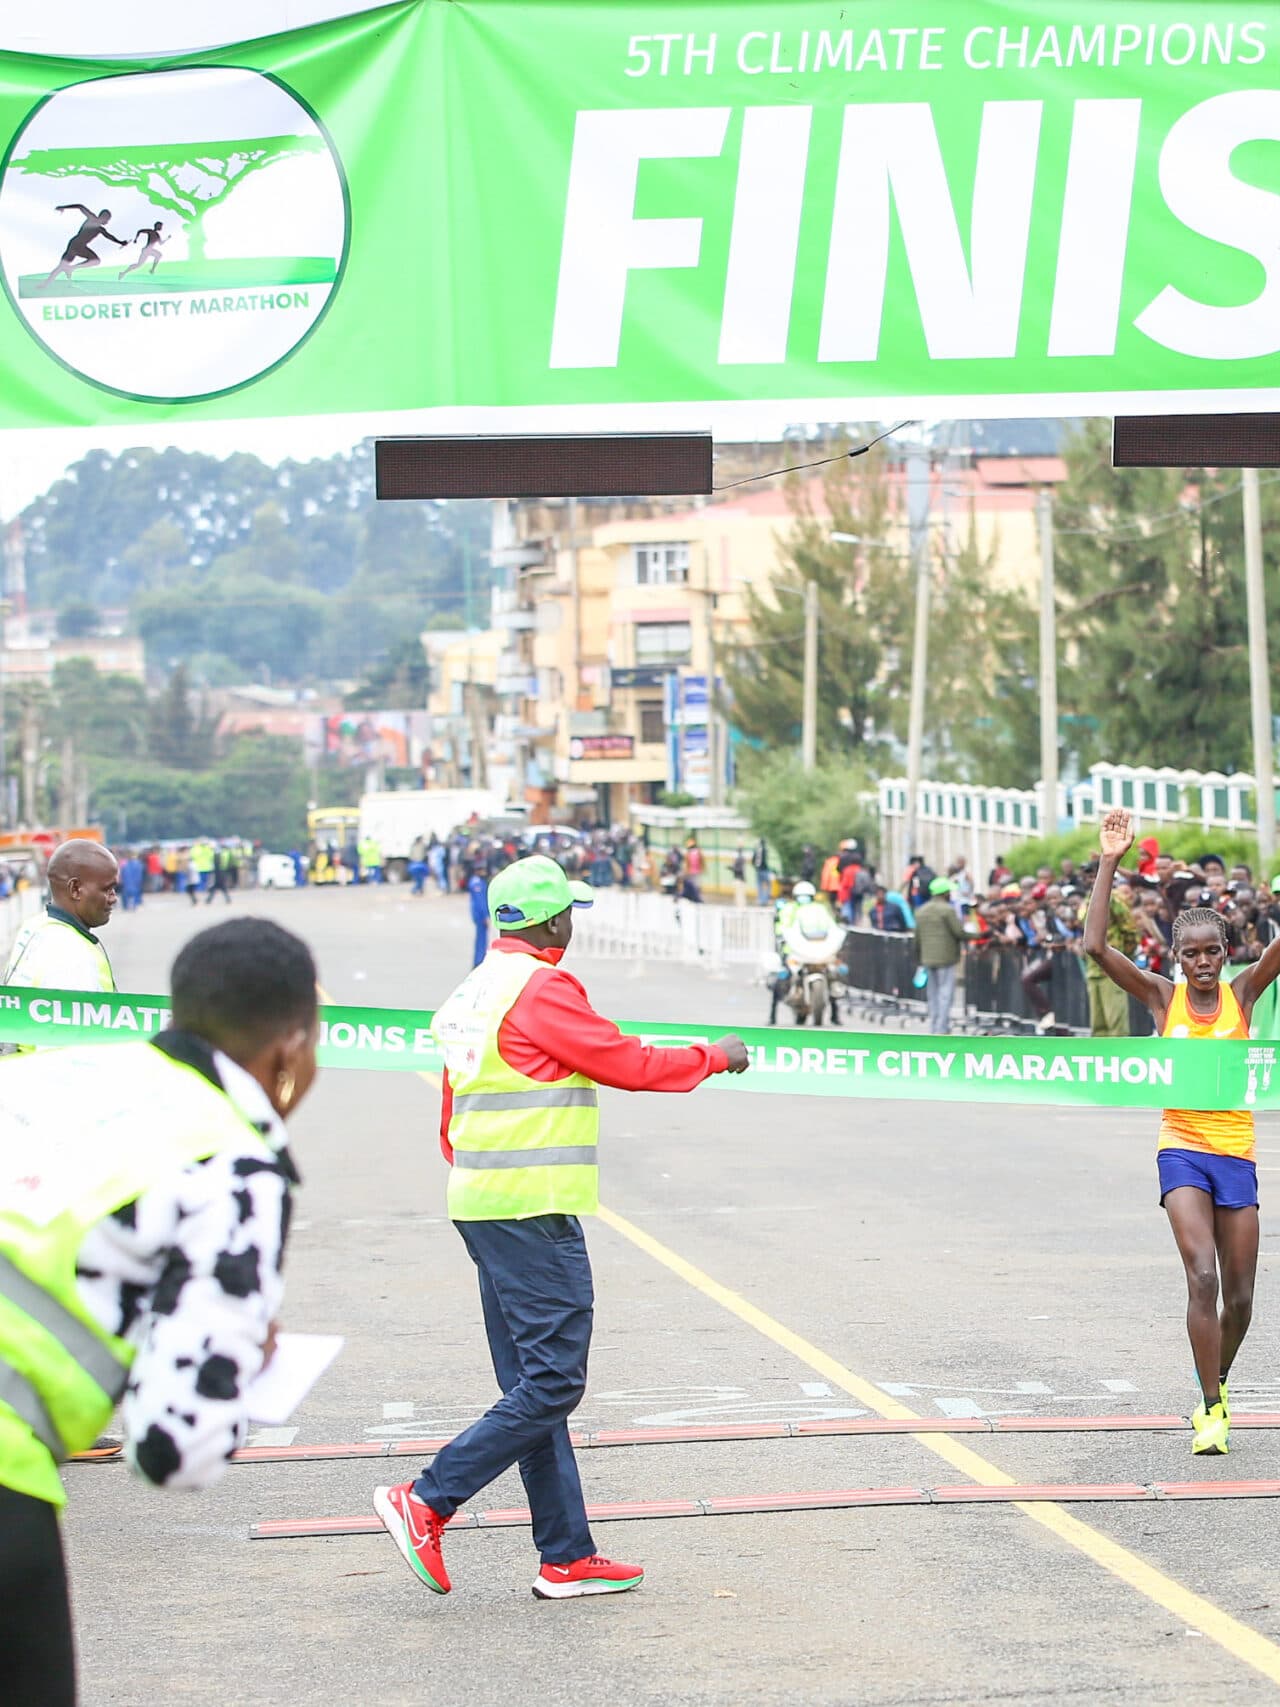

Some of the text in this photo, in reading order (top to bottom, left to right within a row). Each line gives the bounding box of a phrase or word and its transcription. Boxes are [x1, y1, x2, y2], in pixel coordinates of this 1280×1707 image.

[625, 33, 718, 79] 5TH
[735, 27, 946, 76] CLIMATE
[962, 21, 1267, 71] CHAMPIONS
[42, 292, 310, 321] ELDORET CITY MARATHON
[877, 1051, 956, 1079] CITY
[964, 1053, 1173, 1085] MARATHON
